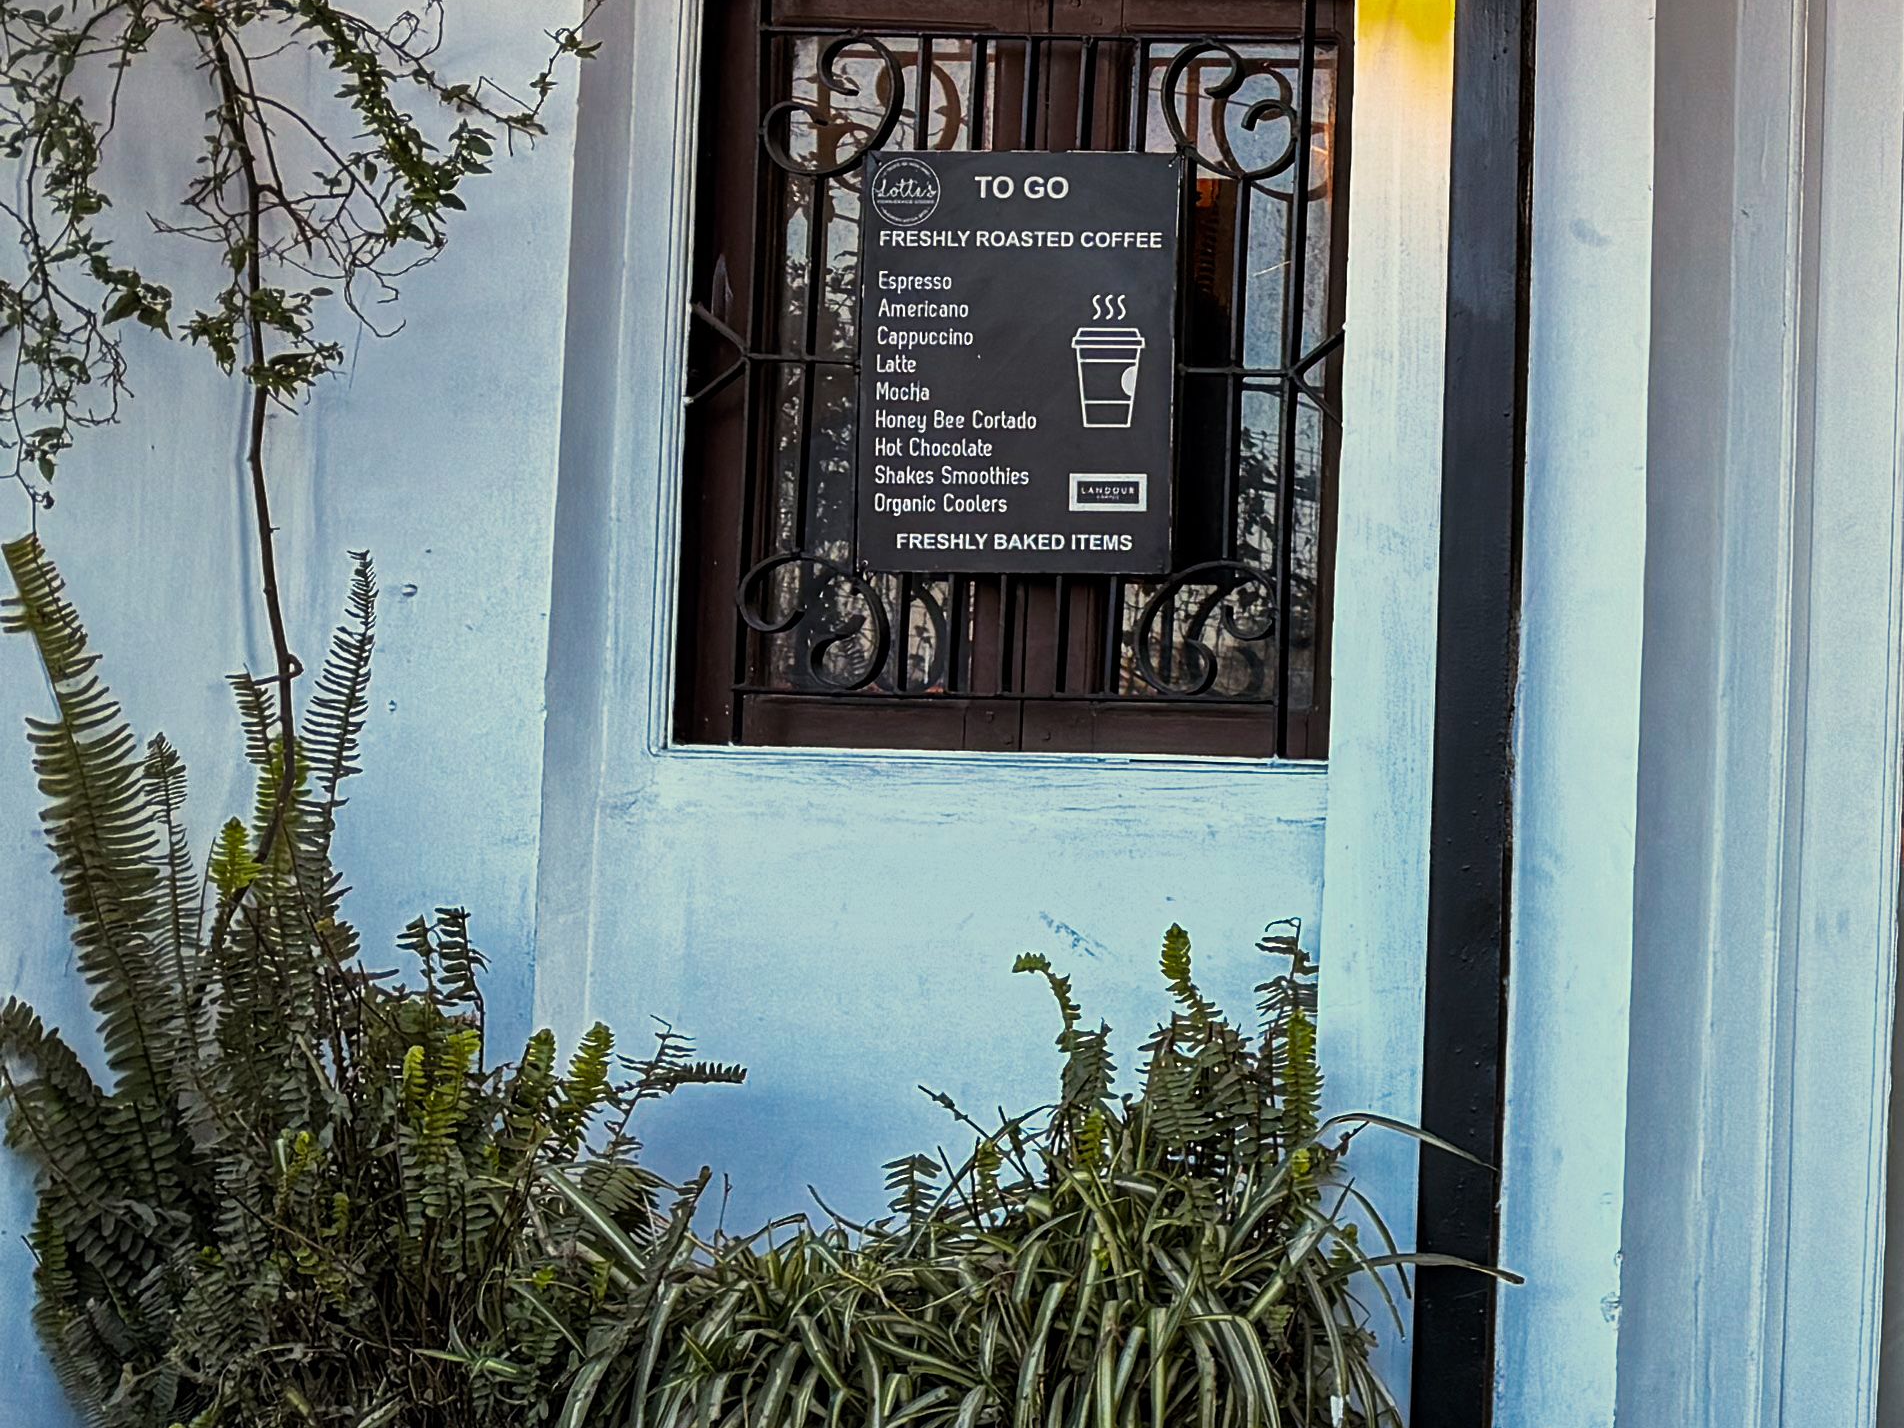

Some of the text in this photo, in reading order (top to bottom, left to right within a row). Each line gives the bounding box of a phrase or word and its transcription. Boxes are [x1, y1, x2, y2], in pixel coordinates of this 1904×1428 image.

[974, 175, 1069, 199] TO GO
[879, 230, 1163, 249] FRESHLY ROASTED COFFEE
[878, 270, 952, 292] Espresso
[878, 297, 969, 318] Americano
[877, 325, 974, 349] Cappuccino
[876, 353, 917, 374] Latte
[875, 381, 930, 403] Mocha
[875, 409, 1037, 433] Honey Bee Cortado
[875, 436, 993, 457] Hot Chocolate
[874, 464, 1030, 485] Shakes Smoothies
[1080, 486, 1135, 495] LANDOUR
[874, 492, 1008, 516] Organic Coolers
[896, 532, 1133, 551] FRESHLY BAKED ITEMS
